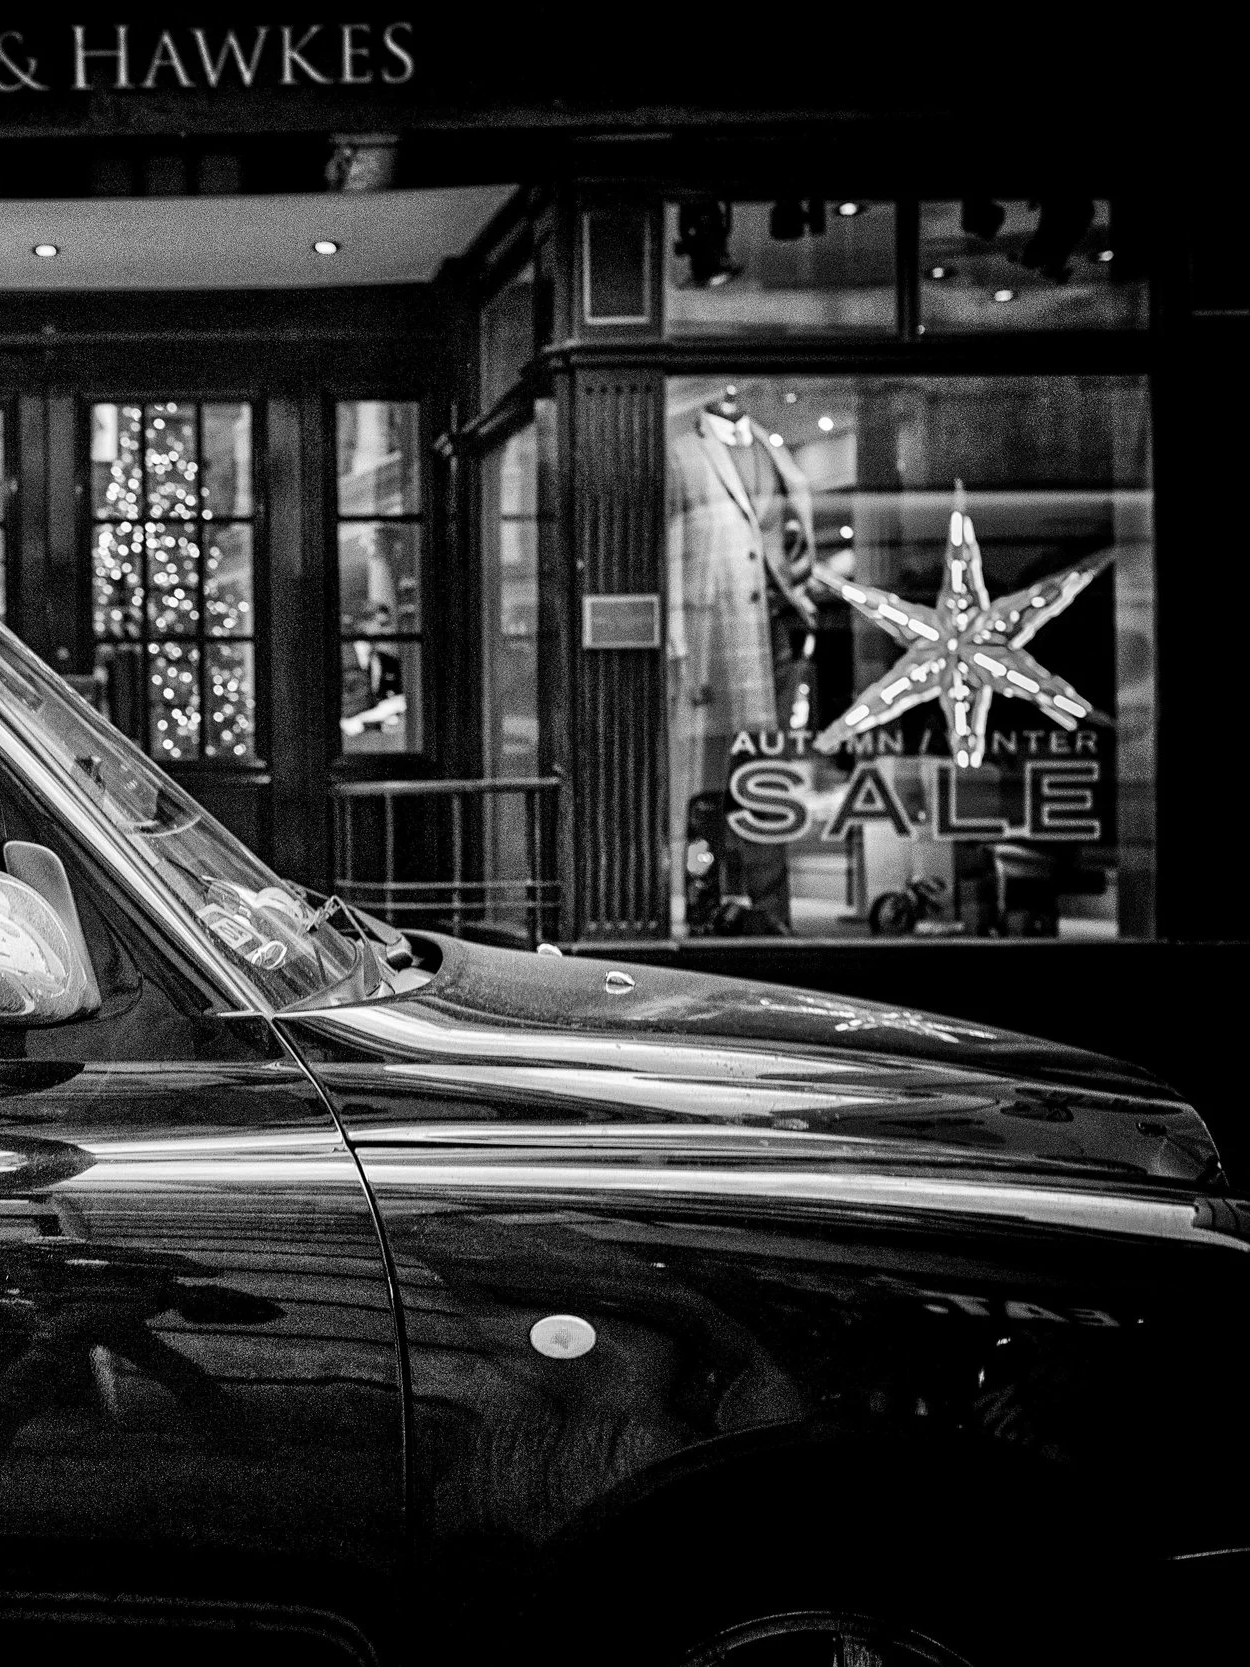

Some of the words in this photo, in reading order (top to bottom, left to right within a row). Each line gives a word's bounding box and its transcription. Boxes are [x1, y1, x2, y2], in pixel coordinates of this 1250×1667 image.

[70, 22, 414, 90] HAWKES
[731, 730, 903, 755] AUTMN
[944, 729, 1098, 754] NTER
[727, 760, 1101, 843] SALE
